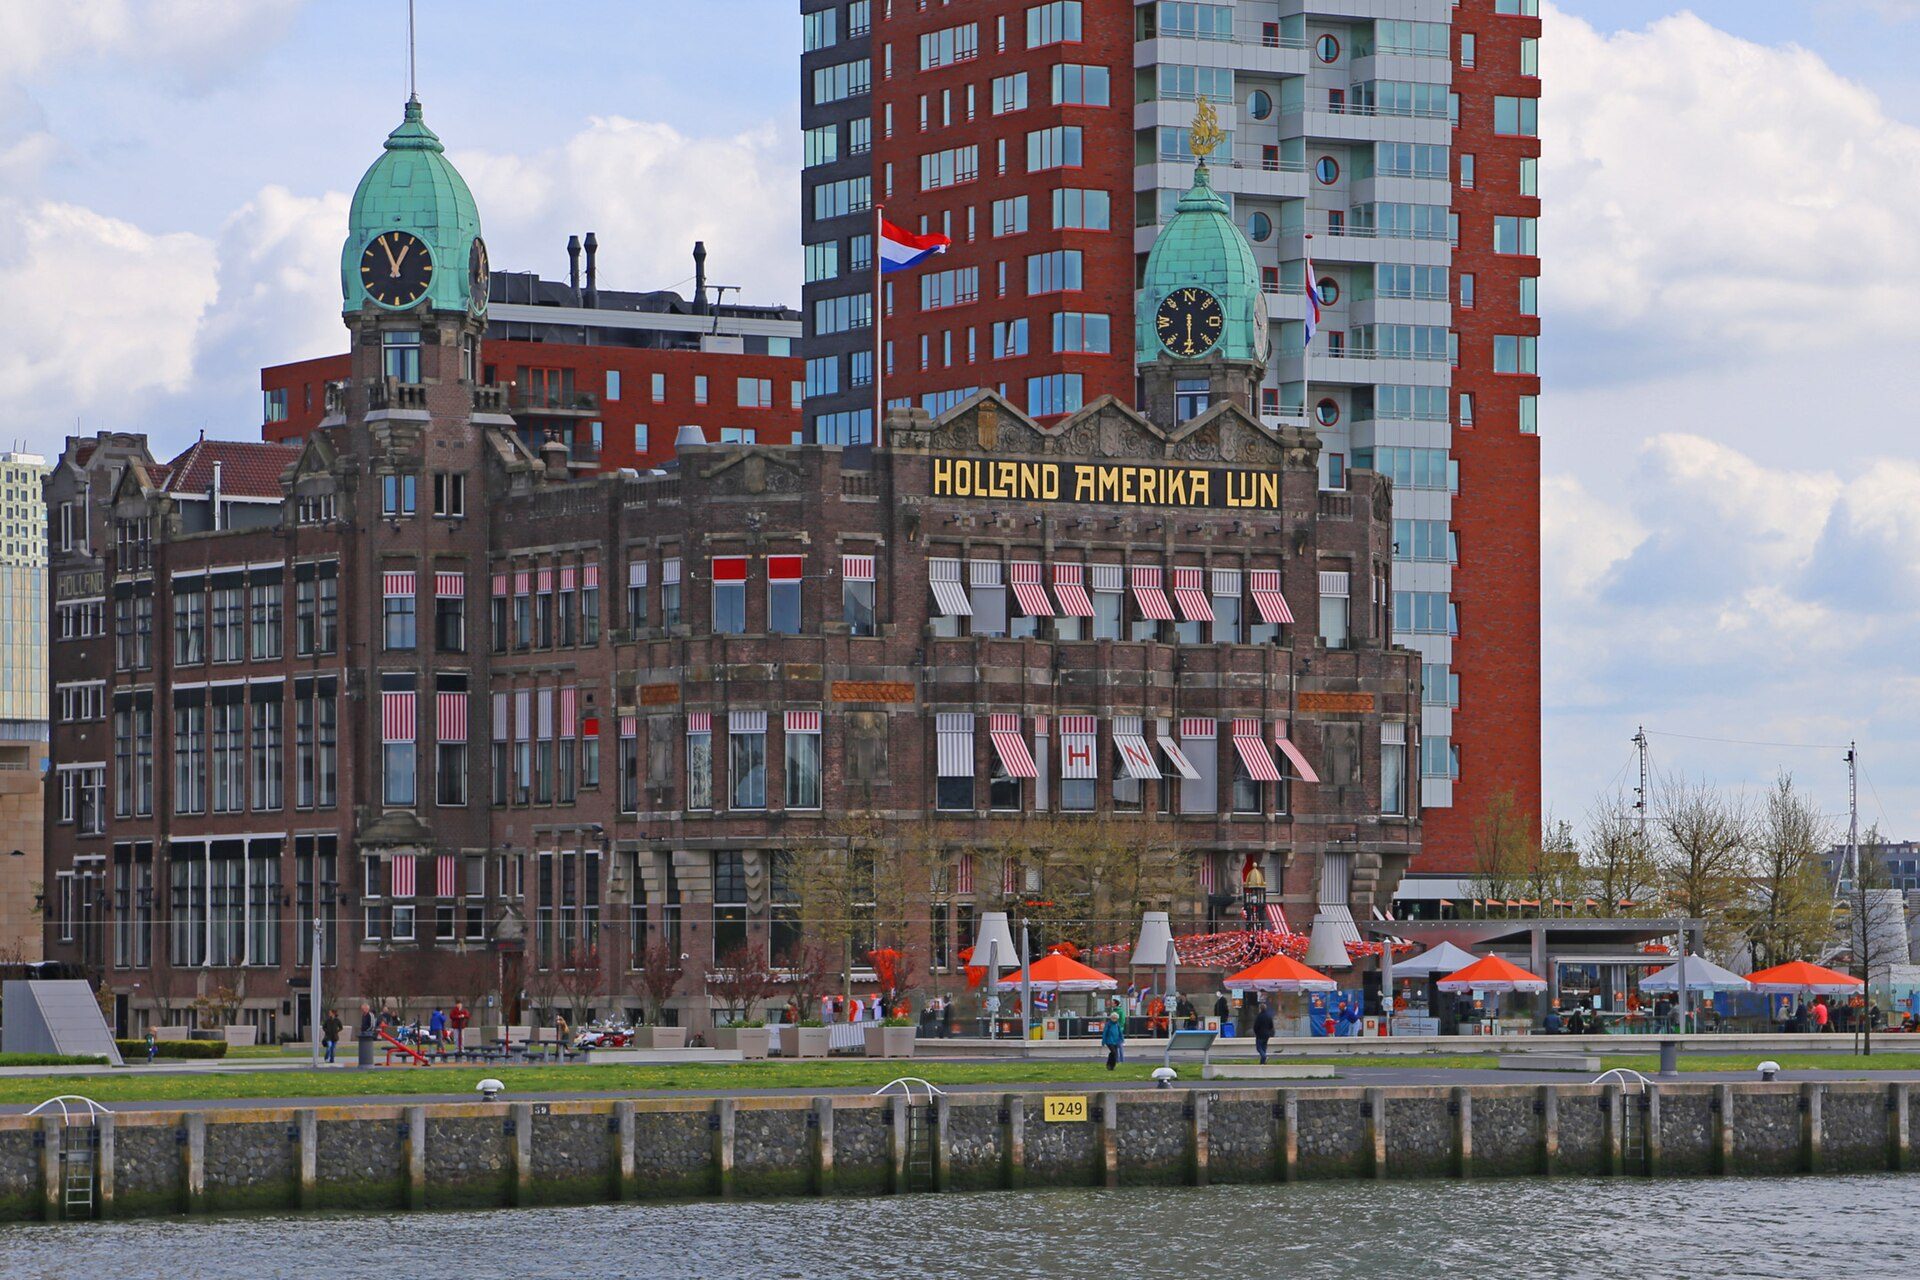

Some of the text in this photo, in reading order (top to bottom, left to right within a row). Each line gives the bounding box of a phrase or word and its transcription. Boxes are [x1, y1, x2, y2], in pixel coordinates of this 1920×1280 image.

[1184, 290, 1197, 301] N
[1158, 314, 1170, 329] W
[1209, 316, 1220, 327] O
[934, 458, 1059, 500] HOLLAND
[1074, 464, 1209, 506] AMERIKA
[57, 571, 104, 597] HOLLAND
[1050, 1101, 1083, 1116] 1249
